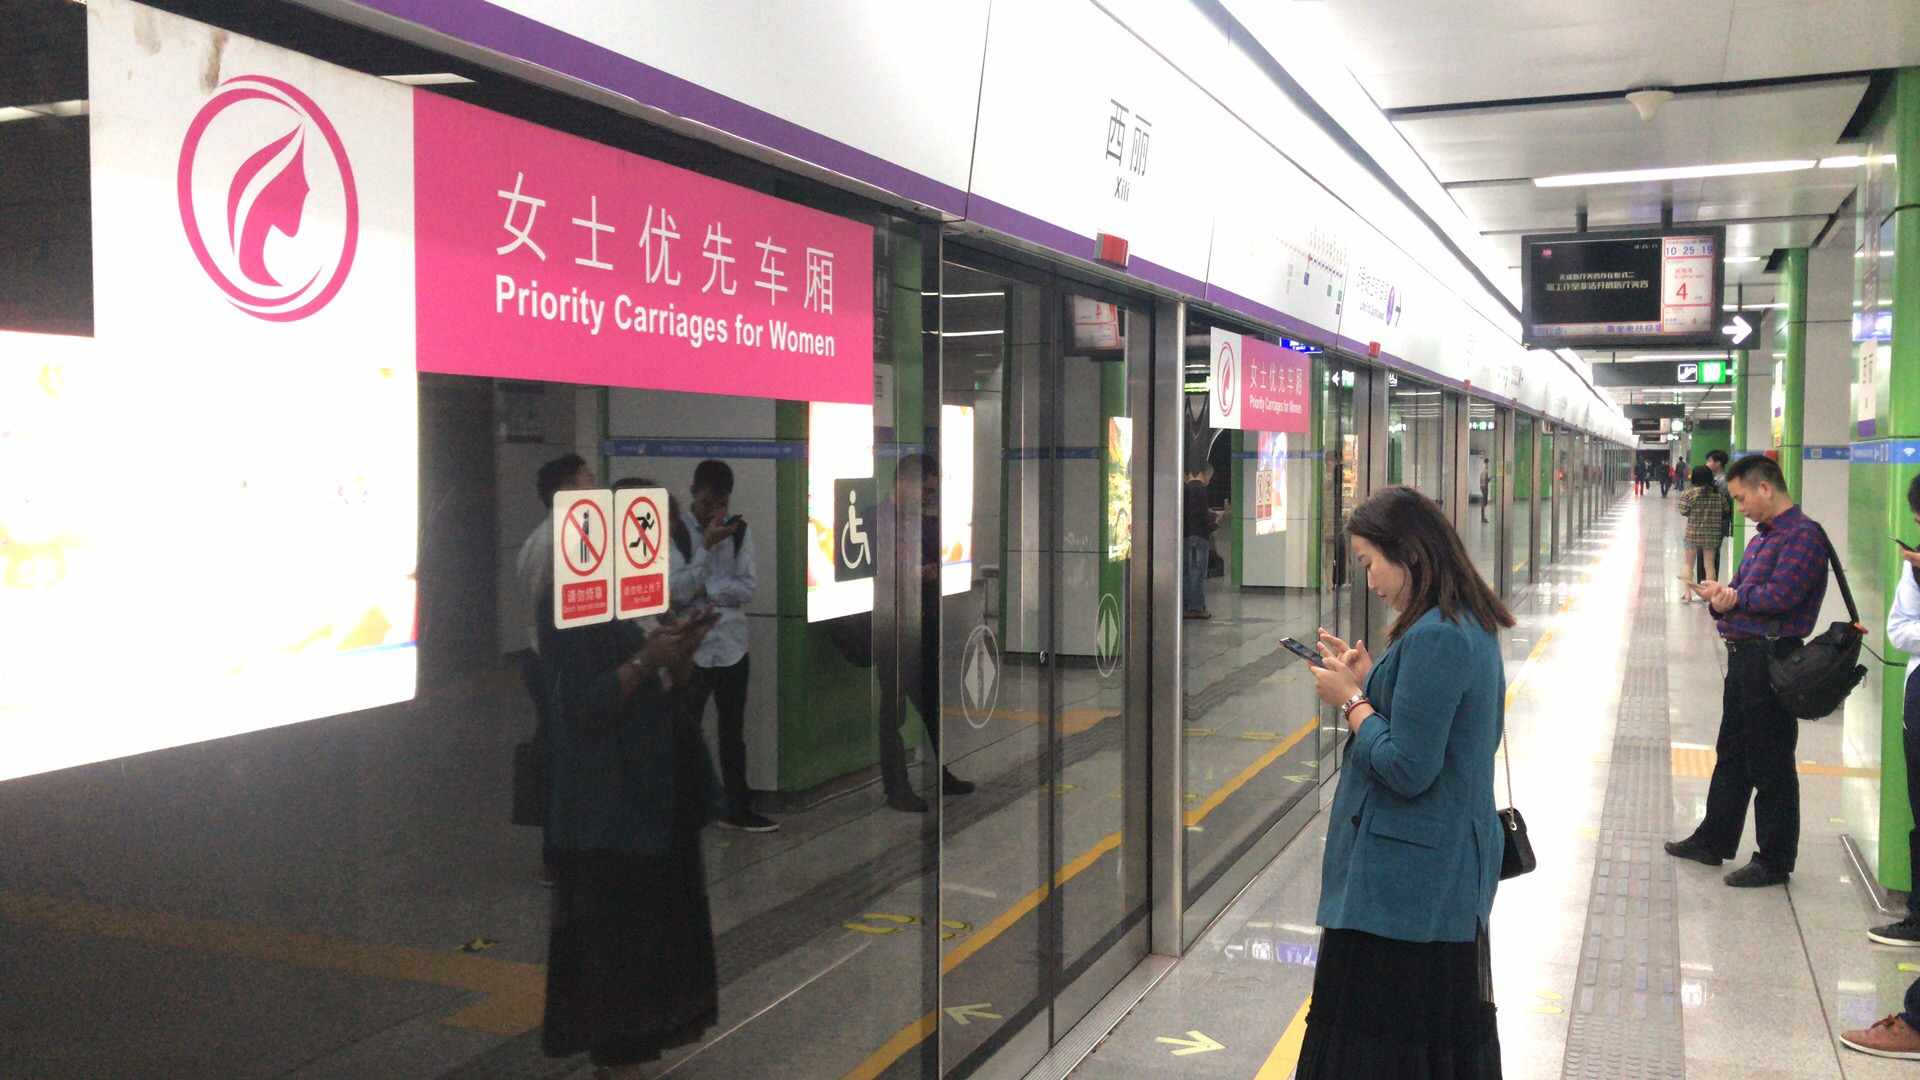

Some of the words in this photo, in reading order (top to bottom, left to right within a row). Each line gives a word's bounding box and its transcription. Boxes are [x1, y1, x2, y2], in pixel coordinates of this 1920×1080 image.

[1105, 98, 1152, 176] 西丽
[1114, 175, 1130, 202] Xili
[496, 171, 835, 315] 女士优先车厢
[495, 274, 605, 336] Priority
[614, 294, 728, 348] Carriages
[735, 313, 764, 347] for
[769, 319, 835, 357] Women
[1675, 282, 1689, 301] 4
